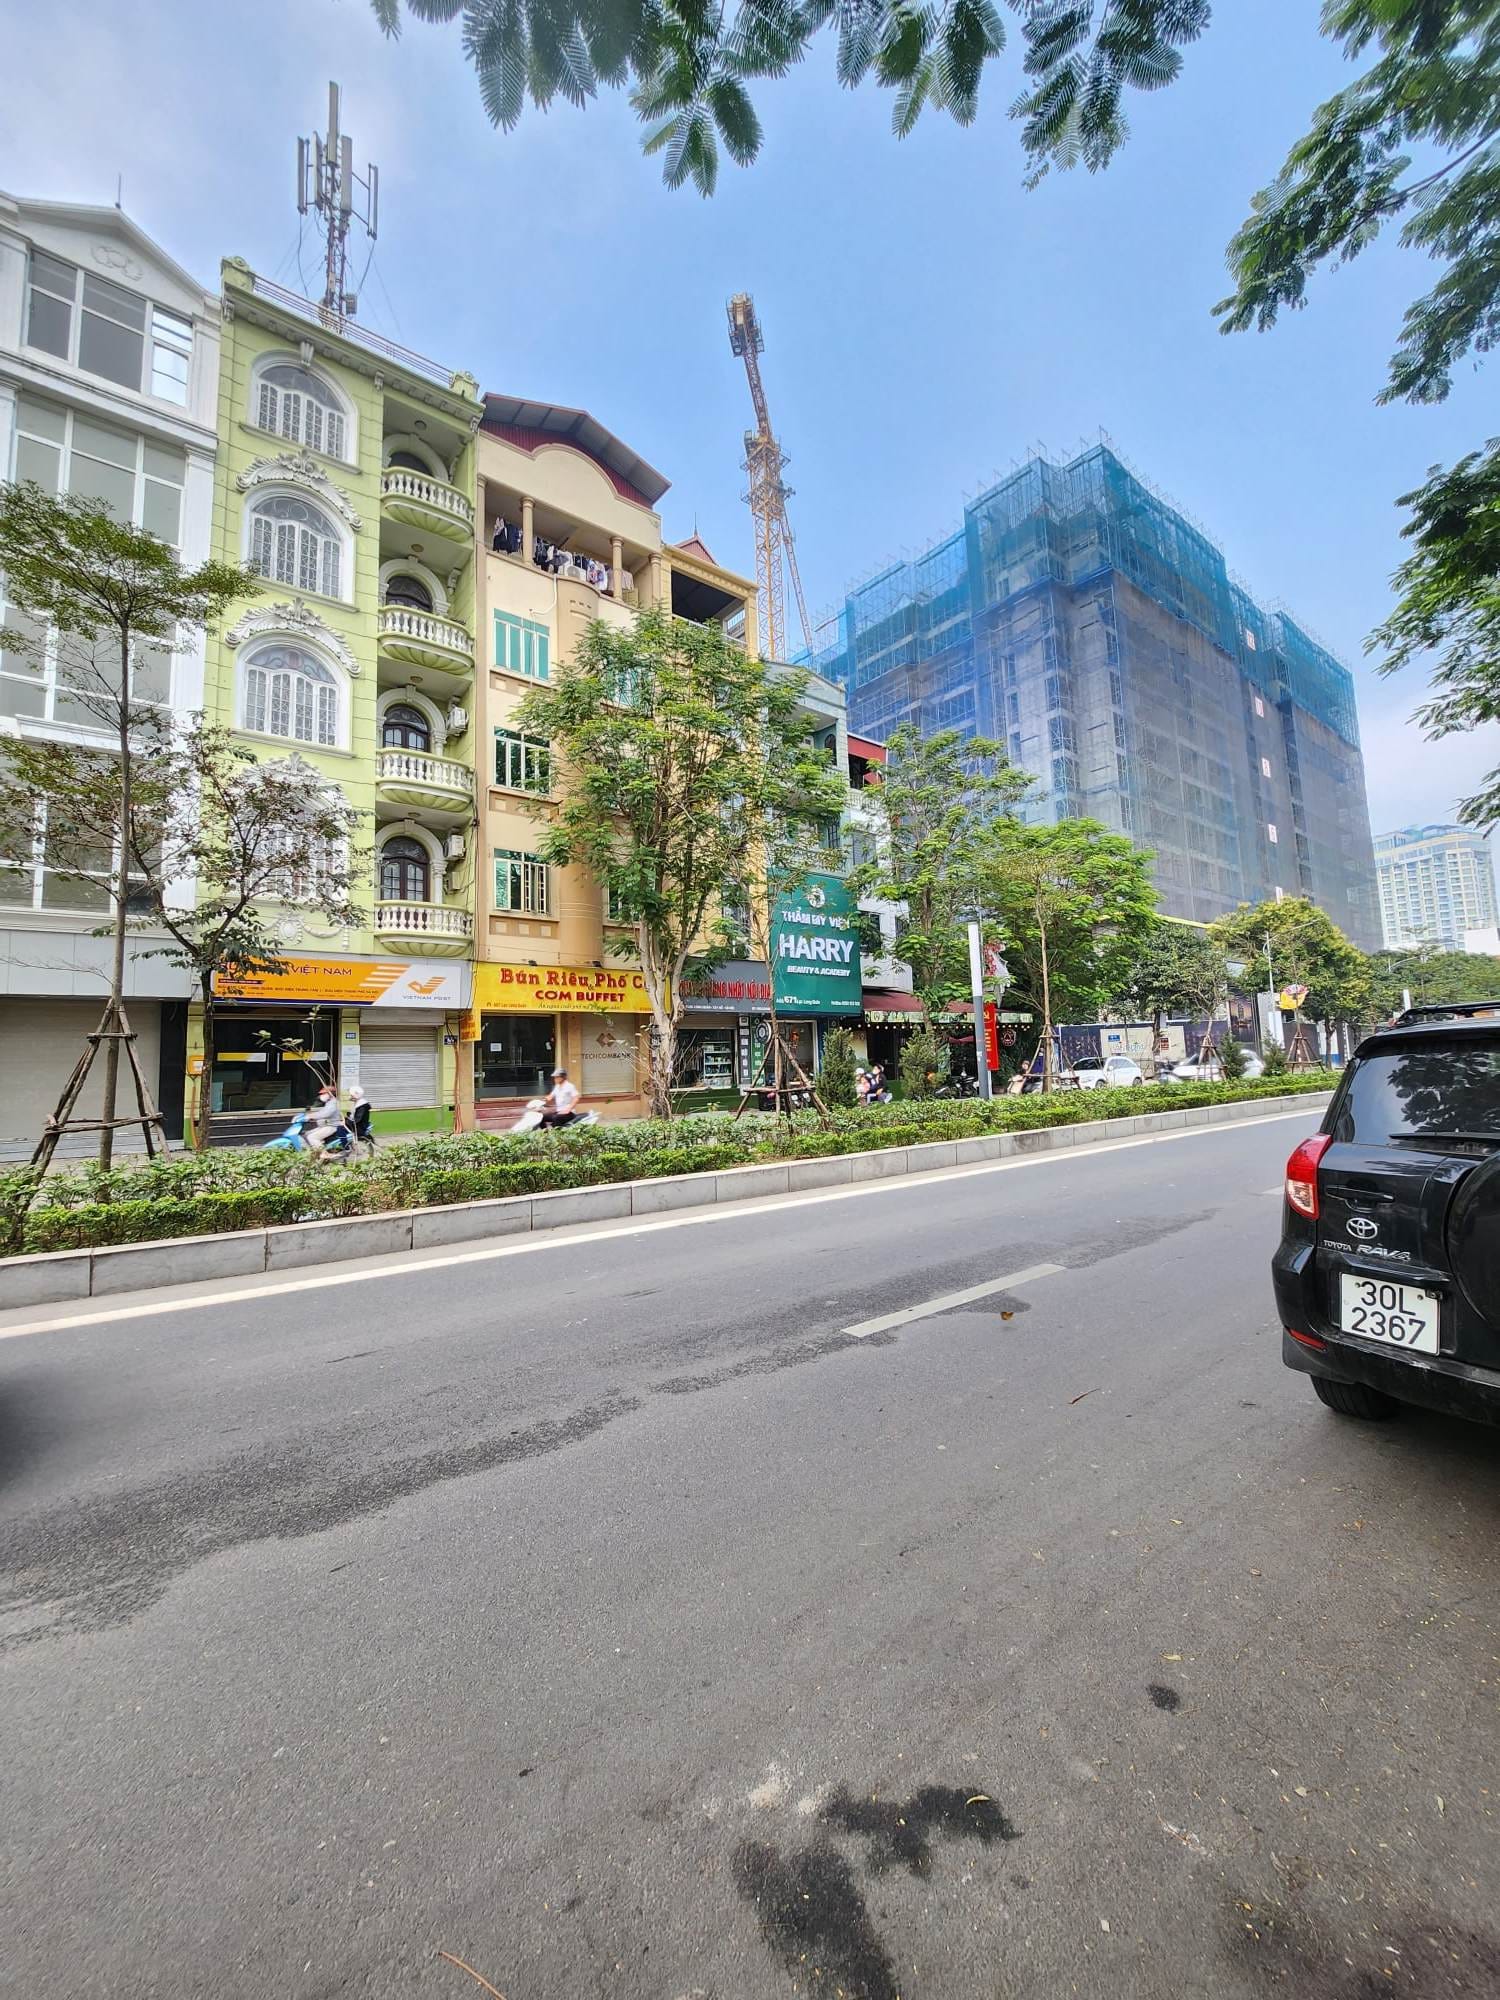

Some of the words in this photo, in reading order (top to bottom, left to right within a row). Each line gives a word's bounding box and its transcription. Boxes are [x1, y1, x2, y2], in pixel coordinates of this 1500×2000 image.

[782, 907, 810, 925] THẨM
[780, 933, 854, 963] HARRY
[291, 964, 319, 975] VIỆT
[323, 968, 352, 976] NAM
[500, 968, 540, 985] Bún
[547, 970, 588, 988] Riêu
[594, 973, 628, 989] Phố
[632, 975, 646, 989] C
[787, 965, 814, 975] BEAUTY
[820, 967, 851, 977] ACADEMY
[576, 992, 625, 1003] BUFFET
[581, 1052, 632, 1060] TECHCOMBANK
[1323, 1239, 1352, 1252] TOYOTA
[1357, 1244, 1411, 1261] RAV4
[1360, 1280, 1417, 1316] 30L
[1351, 1306, 1426, 1345] 2367
